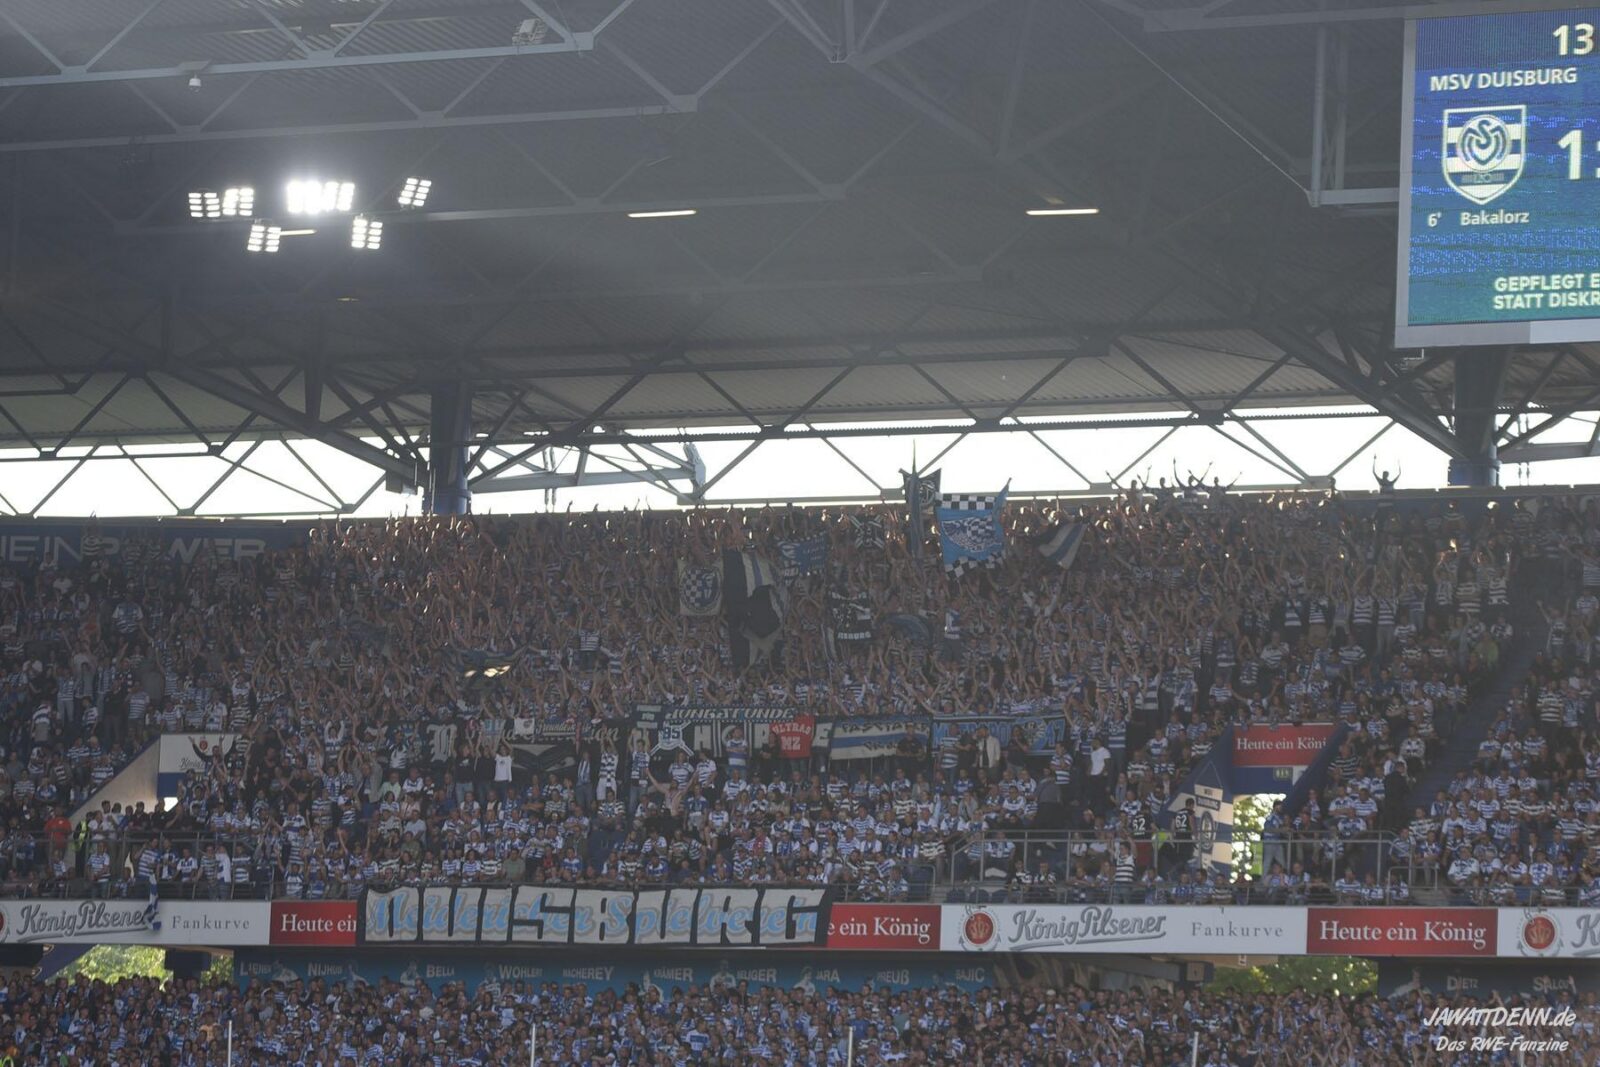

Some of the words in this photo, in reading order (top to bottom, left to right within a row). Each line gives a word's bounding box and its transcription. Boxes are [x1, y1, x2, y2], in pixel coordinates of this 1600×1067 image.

[1553, 24, 1595, 56] 13
[1430, 73, 1472, 92] MSV
[1477, 67, 1578, 89] DUISBURG
[1460, 210, 1530, 226] Bakalorz
[1494, 273, 1585, 292] GEPFLEGT
[1493, 293, 1544, 310] STATT
[1236, 737, 1273, 751] Heute
[1275, 737, 1294, 750] ein
[1297, 736, 1327, 750] Köni
[16, 903, 78, 937] König
[172, 914, 250, 930] Fankurve
[280, 913, 333, 932] Heute
[1008, 909, 1080, 945] König
[1077, 905, 1167, 938] Pilsener
[1191, 921, 1284, 938] Fankurve
[839, 917, 868, 936] ein
[873, 916, 931, 945] König
[1319, 920, 1382, 941] Heute
[1386, 920, 1418, 941] ein
[1424, 919, 1488, 950] König
